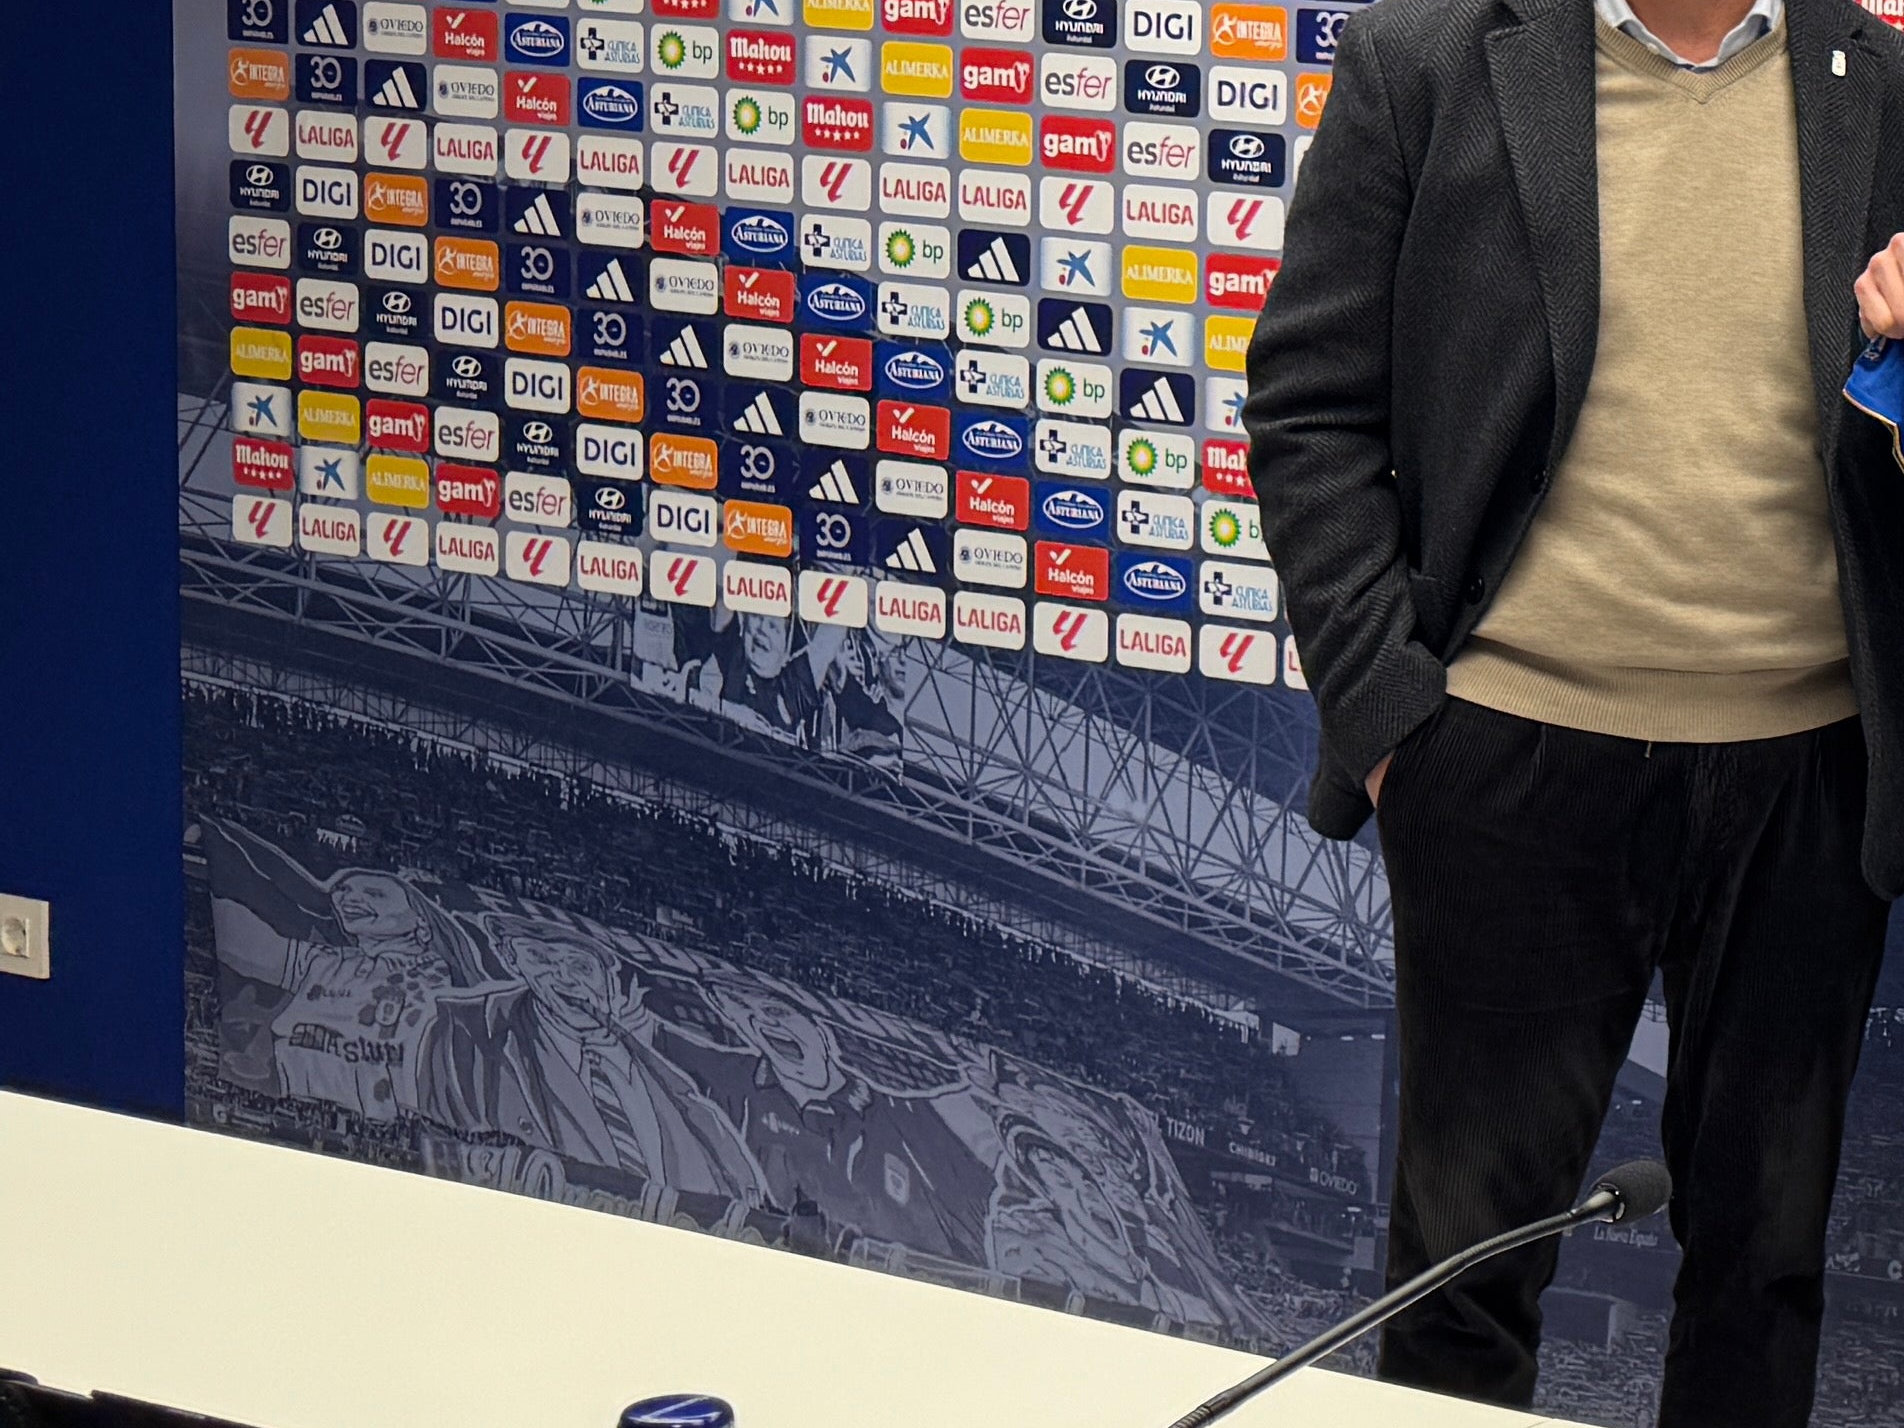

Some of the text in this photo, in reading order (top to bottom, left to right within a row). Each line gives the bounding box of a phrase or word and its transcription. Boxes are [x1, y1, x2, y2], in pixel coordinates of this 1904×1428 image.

[1045, 68, 1112, 99] esfer
[807, 103, 868, 128] Mahou
[299, 125, 354, 147] LALIGA
[303, 179, 351, 206] DIGI
[231, 230, 286, 260] esfer
[664, 225, 705, 245] Halcón
[372, 243, 420, 270] DIGI
[923, 240, 943, 263] bp
[970, 497, 1014, 517] Halcón
[302, 517, 356, 542] LALIGA
[974, 548, 1023, 566] OVIEDO
[725, 575, 787, 603] LALIGA
[1121, 629, 1186, 657] LALIGA
